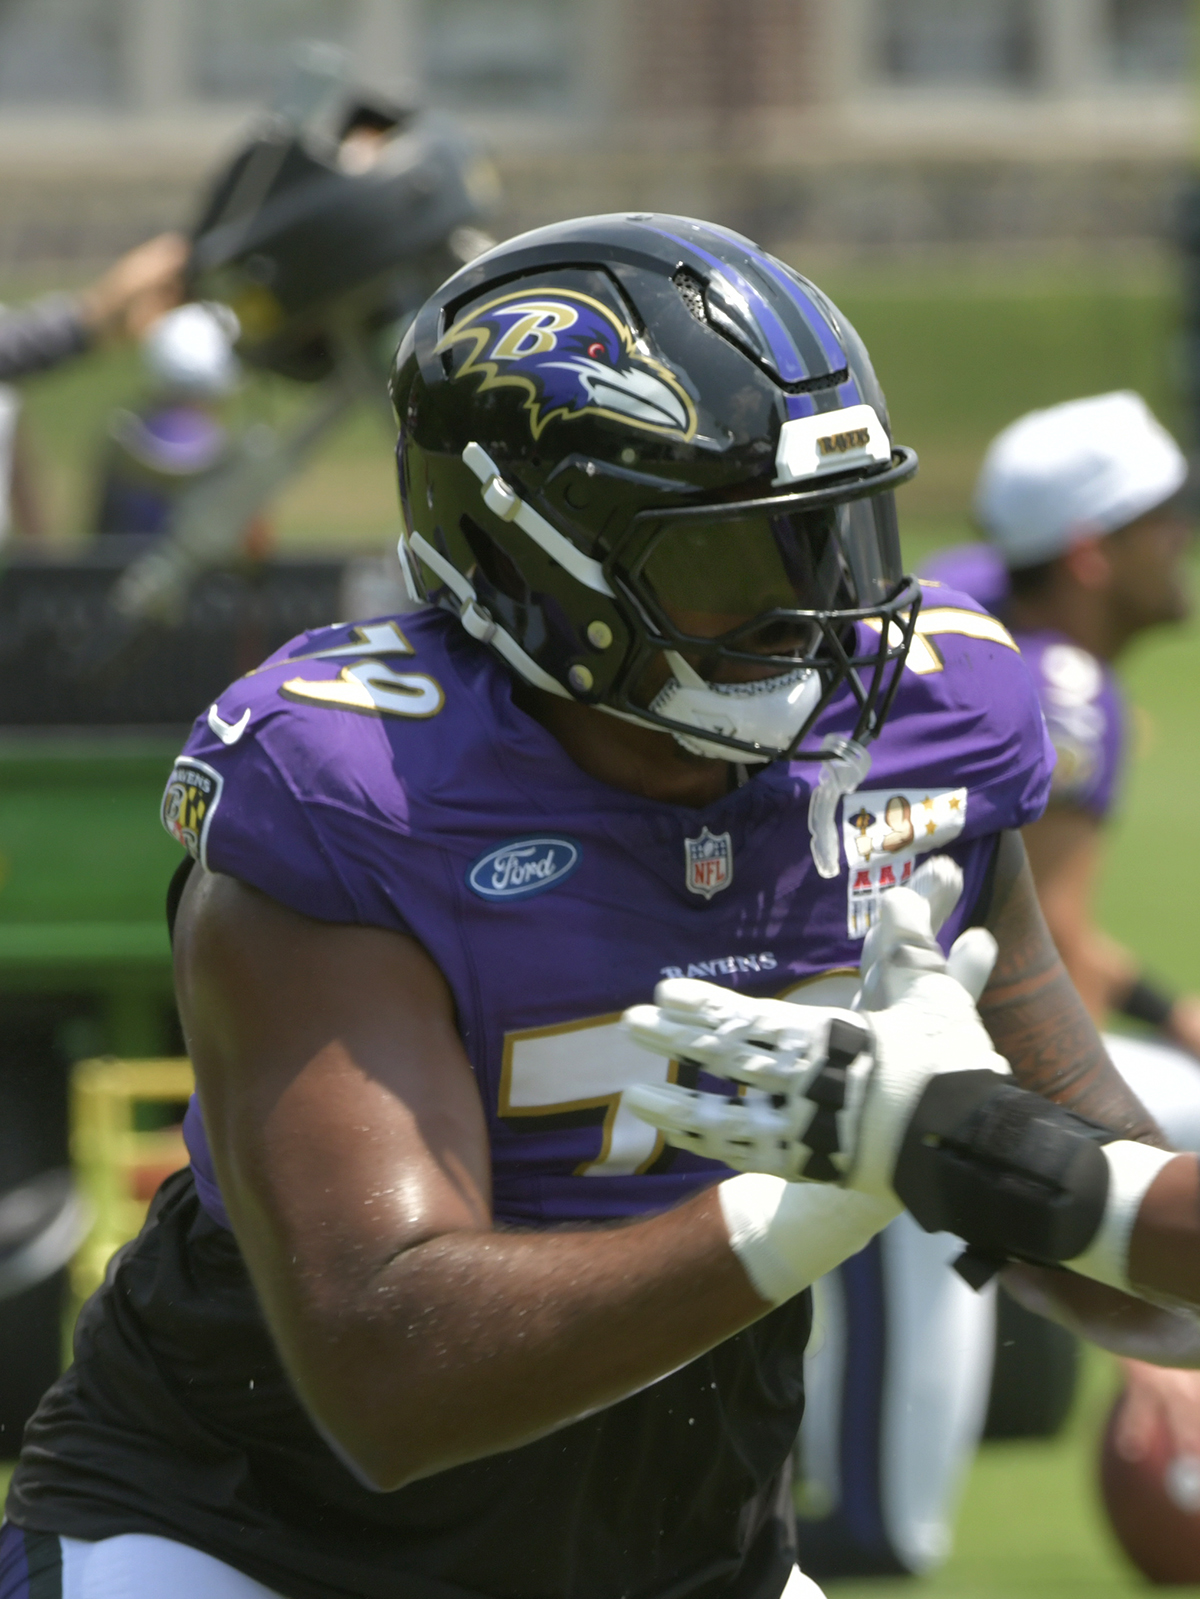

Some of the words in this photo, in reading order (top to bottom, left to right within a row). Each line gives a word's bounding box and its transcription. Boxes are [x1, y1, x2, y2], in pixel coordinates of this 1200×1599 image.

[490, 301, 579, 360] B
[245, 620, 446, 724] 79
[492, 846, 555, 891] Ford
[694, 858, 725, 886] NFL
[660, 951, 778, 979] RAVENS
